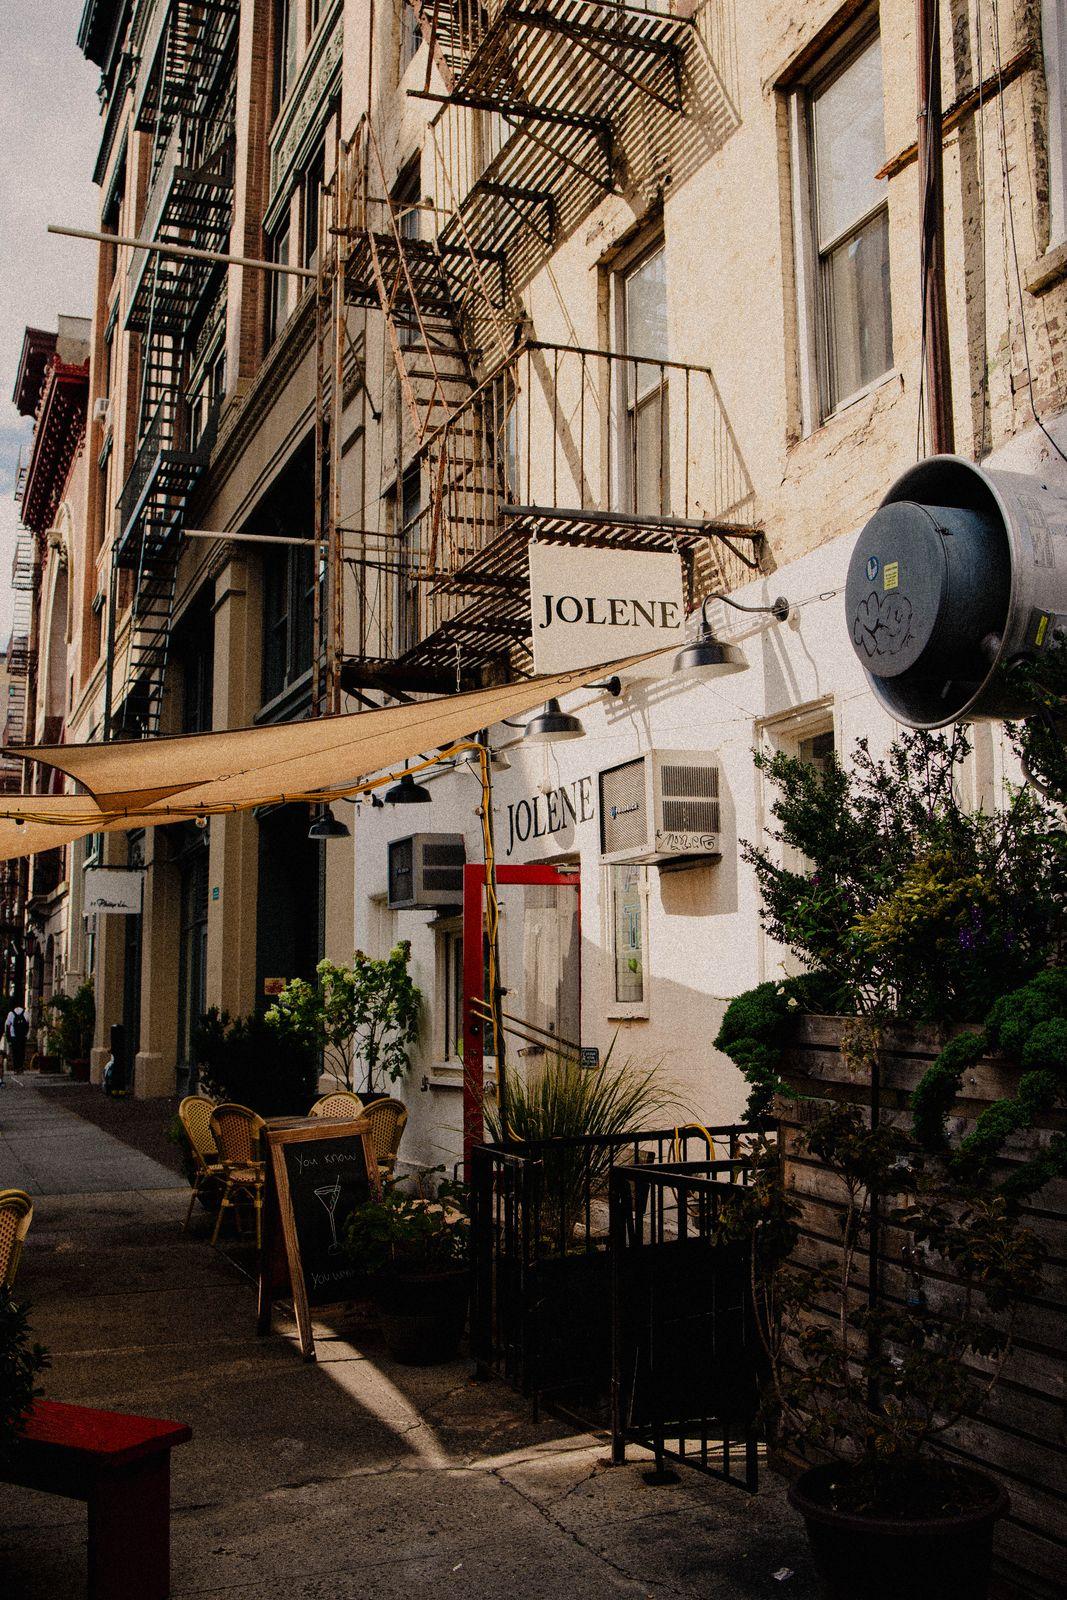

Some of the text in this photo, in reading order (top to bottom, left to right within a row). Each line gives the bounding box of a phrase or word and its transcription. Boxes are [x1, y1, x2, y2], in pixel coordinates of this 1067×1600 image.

[539, 594, 681, 629] JOLENE
[506, 776, 595, 857] JOLENE
[295, 1153, 319, 1175] You
